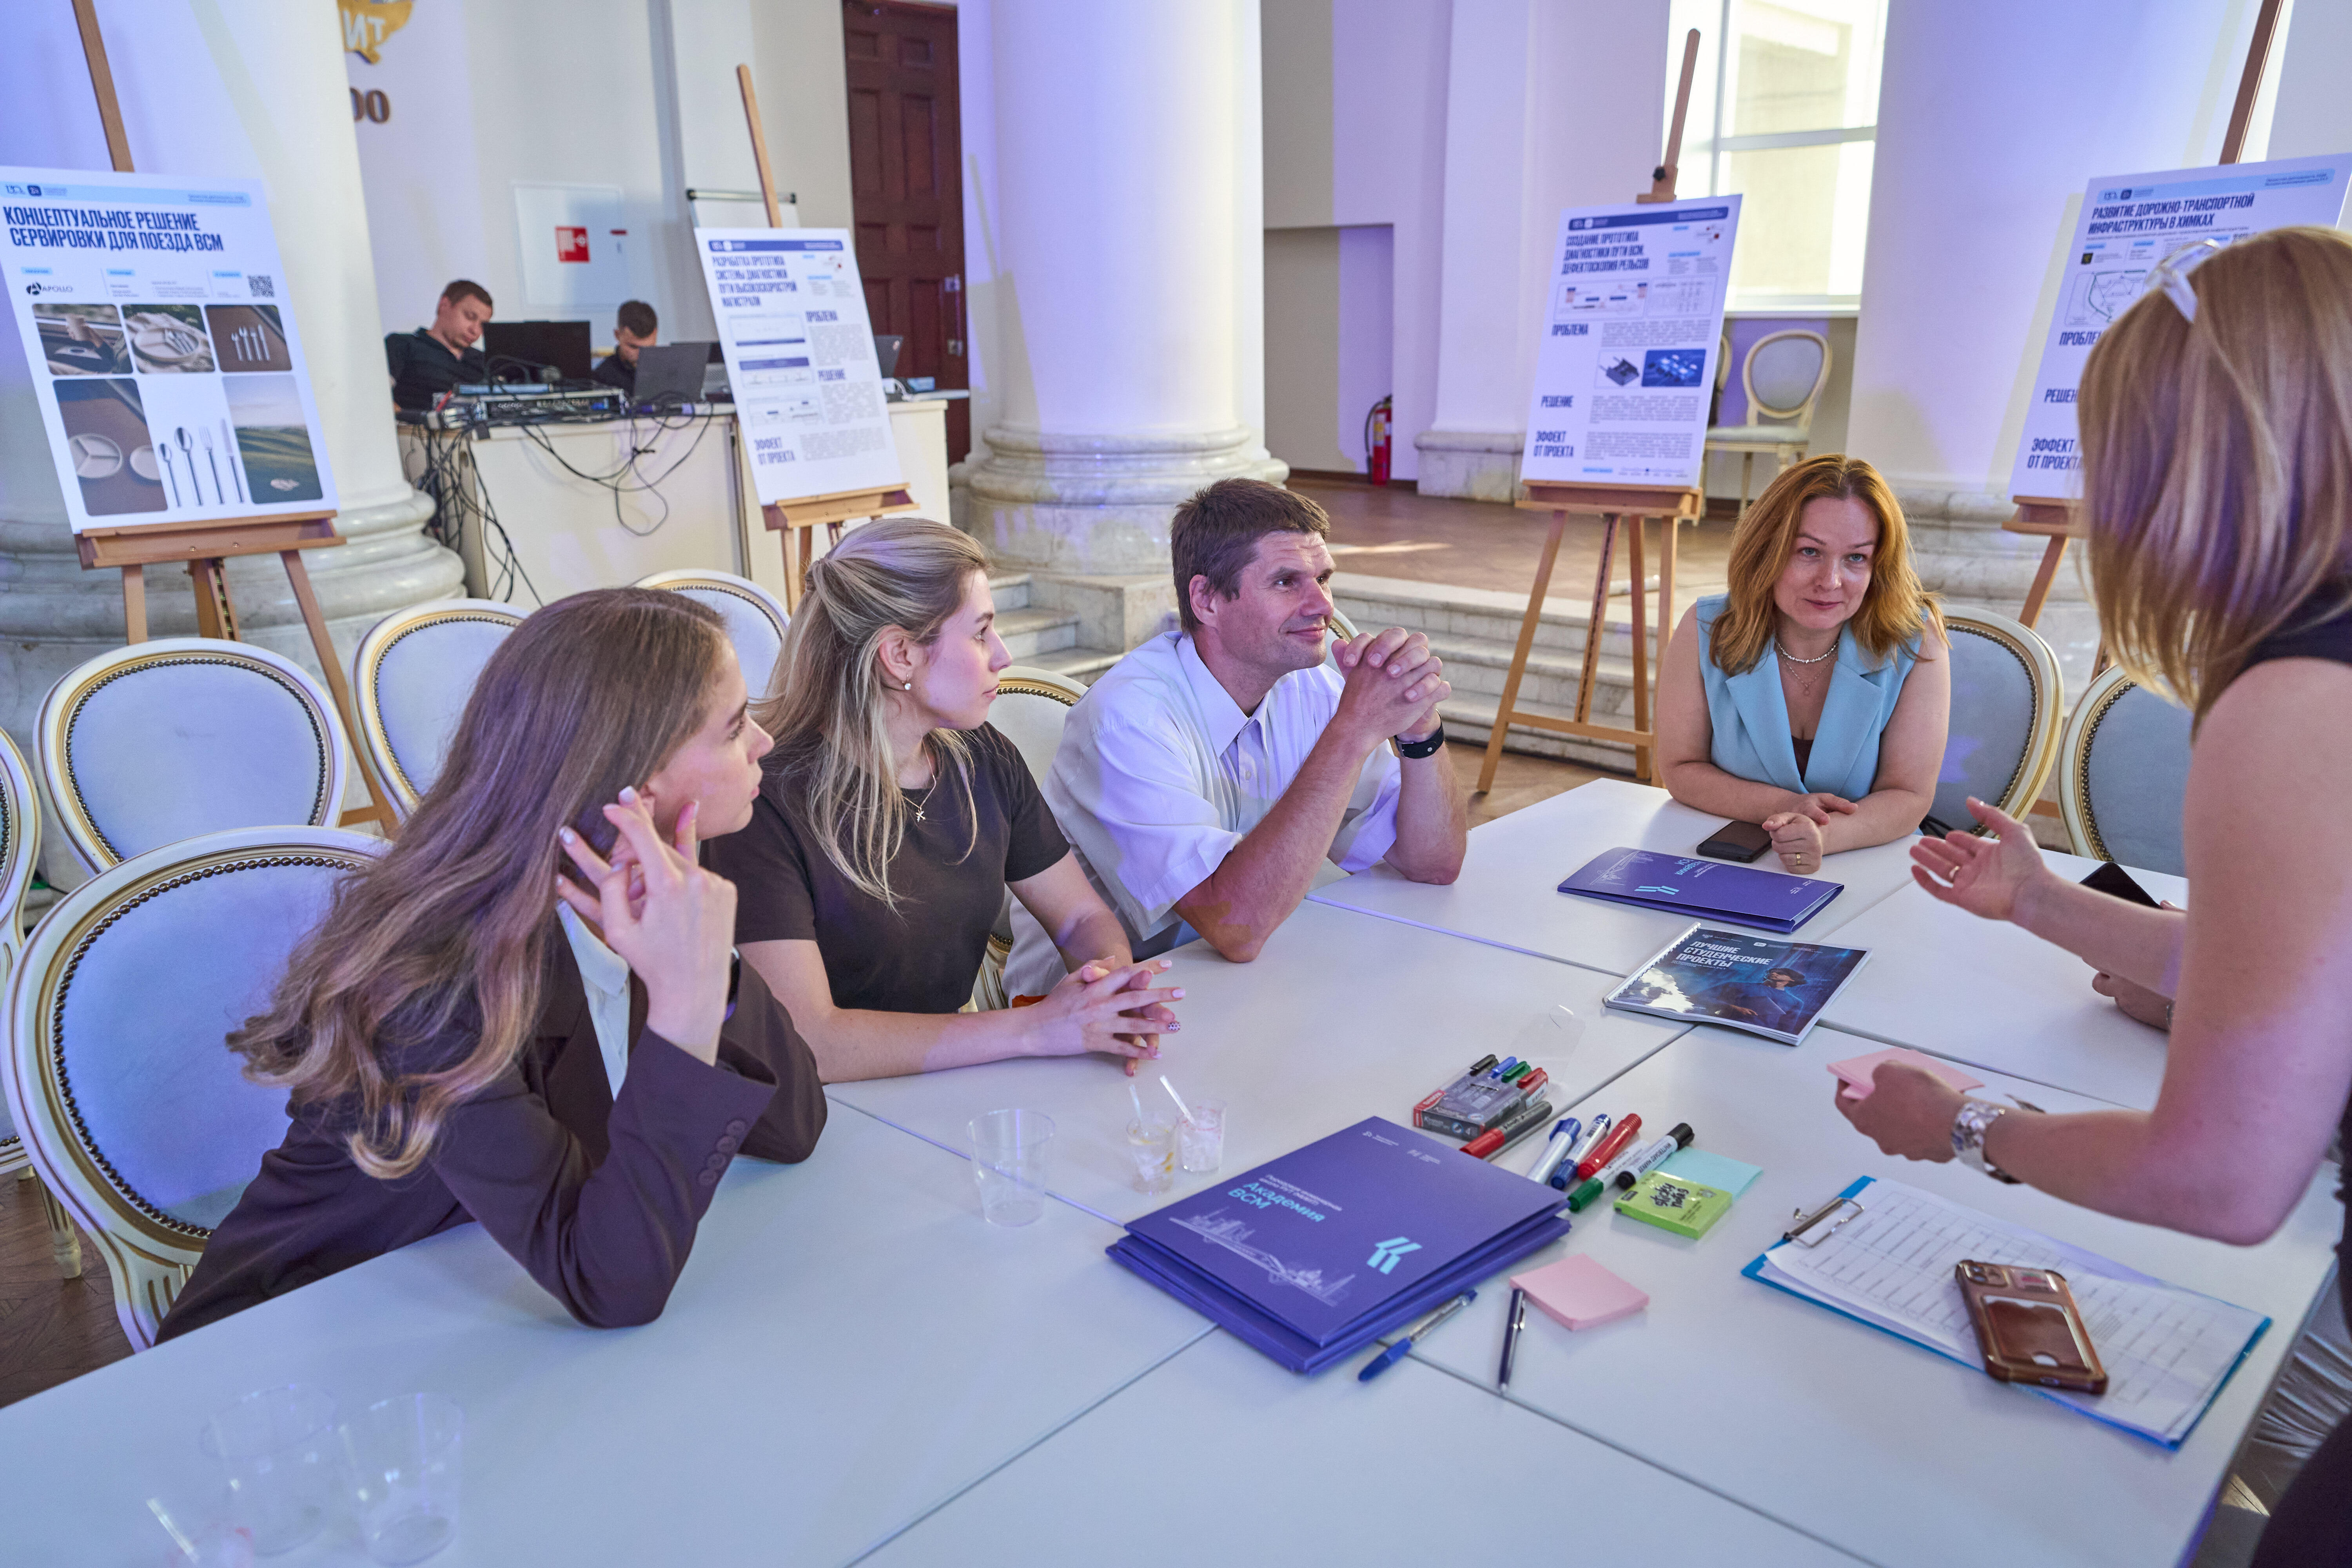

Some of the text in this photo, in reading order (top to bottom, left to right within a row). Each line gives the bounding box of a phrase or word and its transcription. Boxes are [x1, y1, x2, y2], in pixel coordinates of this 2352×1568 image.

[2091, 192, 2255, 220] РАЗВИТИЕ ДОРОЖНО-ТРАНСПОРТНОЙ
[2, 207, 200, 230] КОНЦЕПТУАЛЬНОЕ РЕШЕНИЕ
[2087, 217, 2168, 235] ИНФРАСТРУКТУРЫ
[2168, 216, 2177, 228] В
[2176, 214, 2214, 227] ХИМКАХ
[10, 227, 224, 252] СЕРВИРОВКИ ДЛЯ ПОЕЗДА ВСМ
[805, 310, 838, 322] ПРОБЛЕМА
[1552, 323, 1589, 337] ПРОБЛЕМА
[818, 368, 846, 381] РЕШЕНИЕ
[1541, 395, 1575, 408] РЕШЕНИЕ
[754, 437, 783, 450] ЭФФЕКТ
[1535, 430, 1566, 443] ЭФФЕКТ
[1533, 445, 1544, 457] ОТ
[1543, 445, 1575, 458] ПРОЕКТА
[2032, 439, 2074, 452] ЭФФЕКТ
[758, 451, 795, 465] ОТ ПРОЕКТА
[2027, 456, 2041, 468] ОТ
[1690, 941, 1741, 954] ЛУЧШИЕ
[1676, 953, 1733, 967] ПРОЕКТЫ
[1683, 947, 1773, 965] СТУДЕНЧЕСКИЕ
[1651, 1142, 1672, 1161] WHITEBOARD
[1638, 1160, 1652, 1173] MARKER
[1229, 1188, 1271, 1209] ВСМ
[1243, 1182, 1325, 1222] Академия
[1650, 1183, 1675, 1207] sticky
[1671, 1188, 1690, 1208] notes
